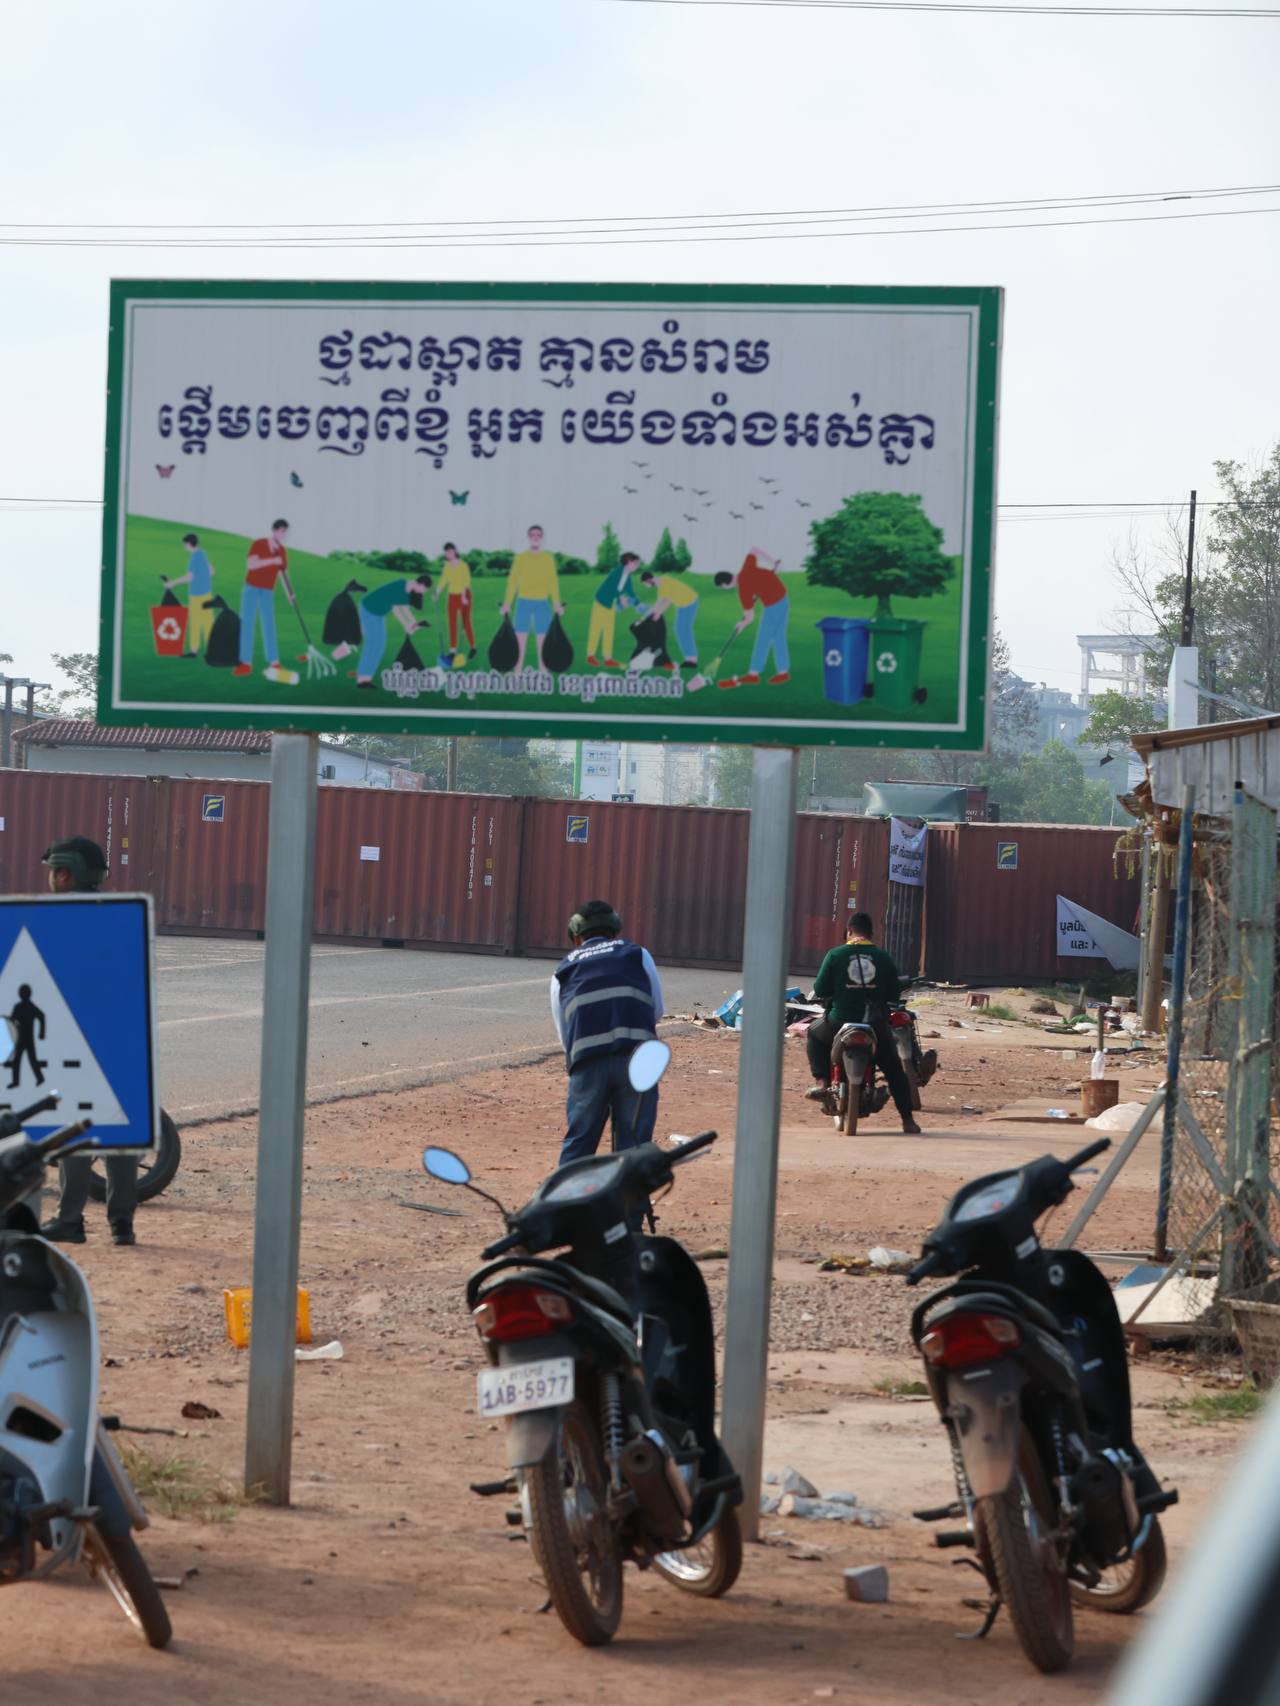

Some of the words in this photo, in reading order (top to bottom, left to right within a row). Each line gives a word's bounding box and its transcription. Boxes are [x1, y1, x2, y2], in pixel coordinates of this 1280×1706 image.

[539, 319, 770, 388] គ្មានសំរាម
[467, 407, 545, 459] អ្នក
